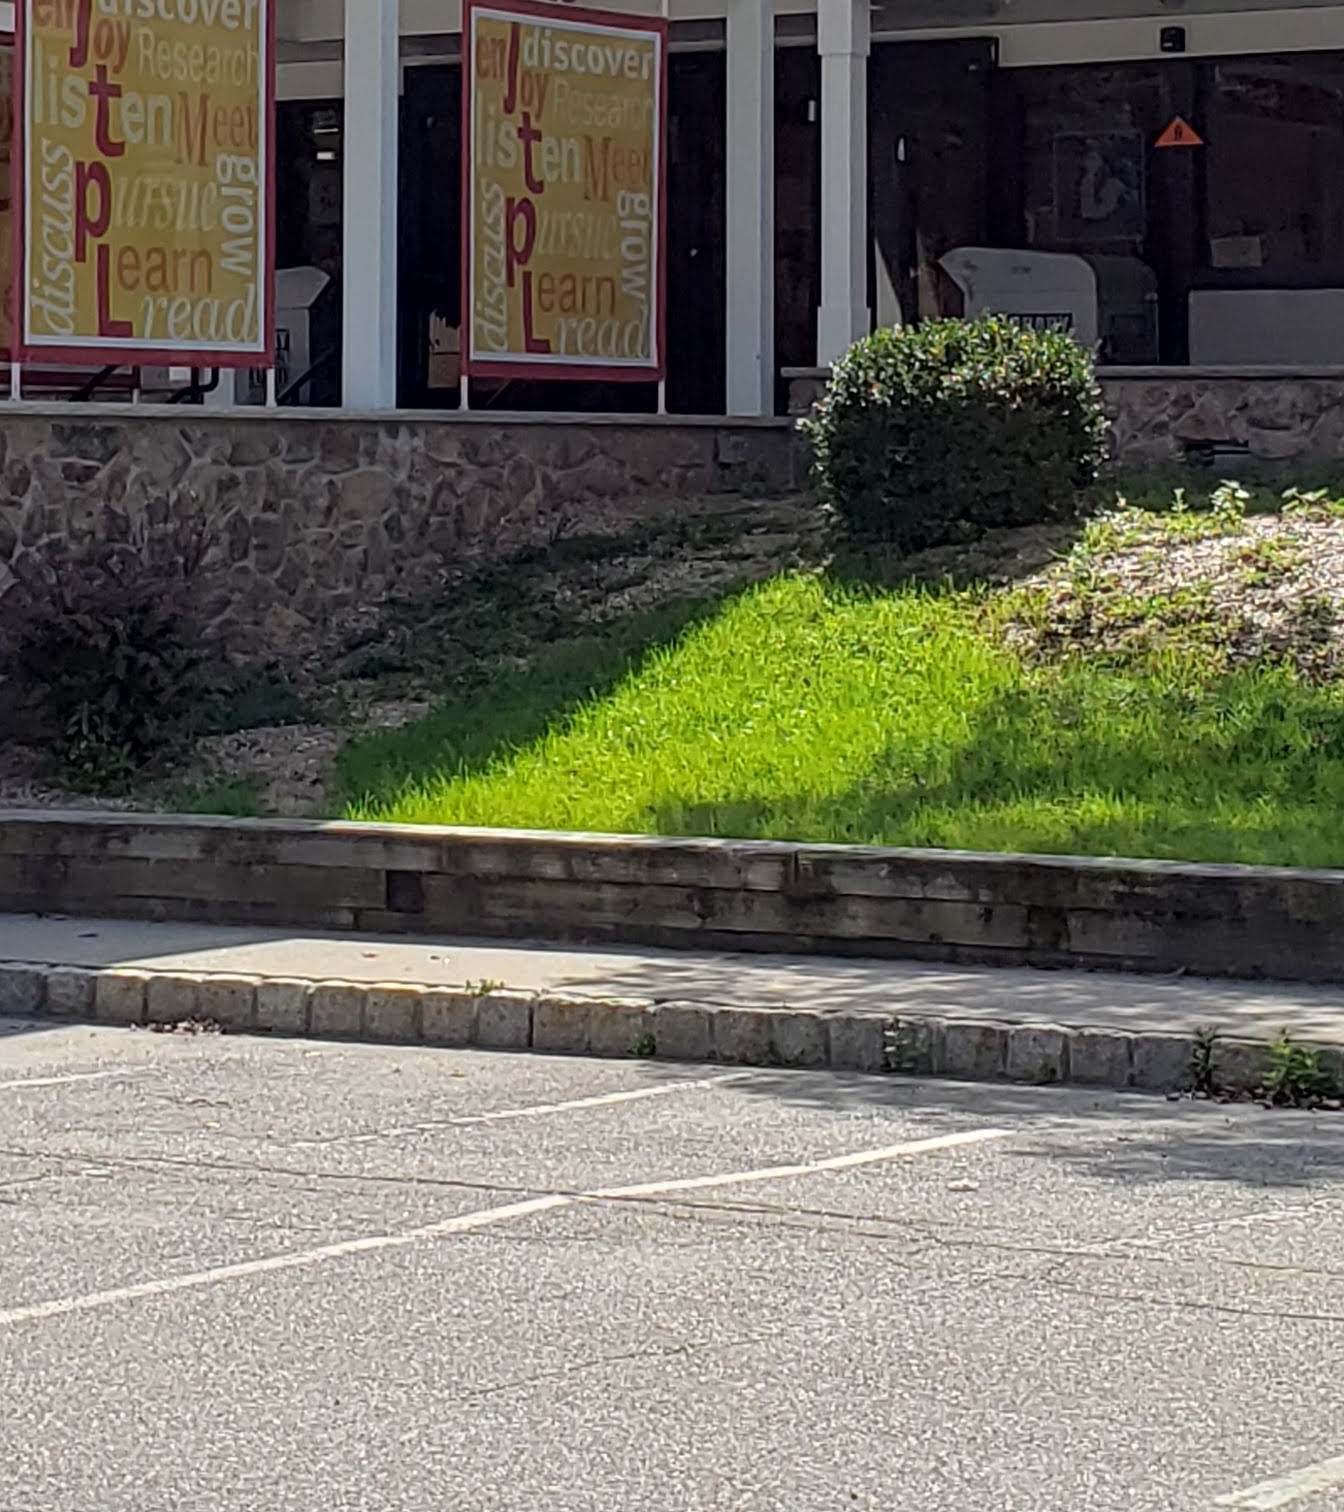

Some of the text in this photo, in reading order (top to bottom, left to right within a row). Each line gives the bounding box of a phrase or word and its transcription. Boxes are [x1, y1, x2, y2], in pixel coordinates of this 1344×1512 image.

[138, 26, 258, 87] Research
[522, 26, 653, 81] discover
[175, 91, 257, 168] Meet
[31, 137, 74, 337] discuss
[215, 153, 259, 277] grow
[617, 190, 653, 304] grow
[474, 178, 506, 352] discuss
[142, 283, 256, 343] read
[558, 304, 648, 359] read
